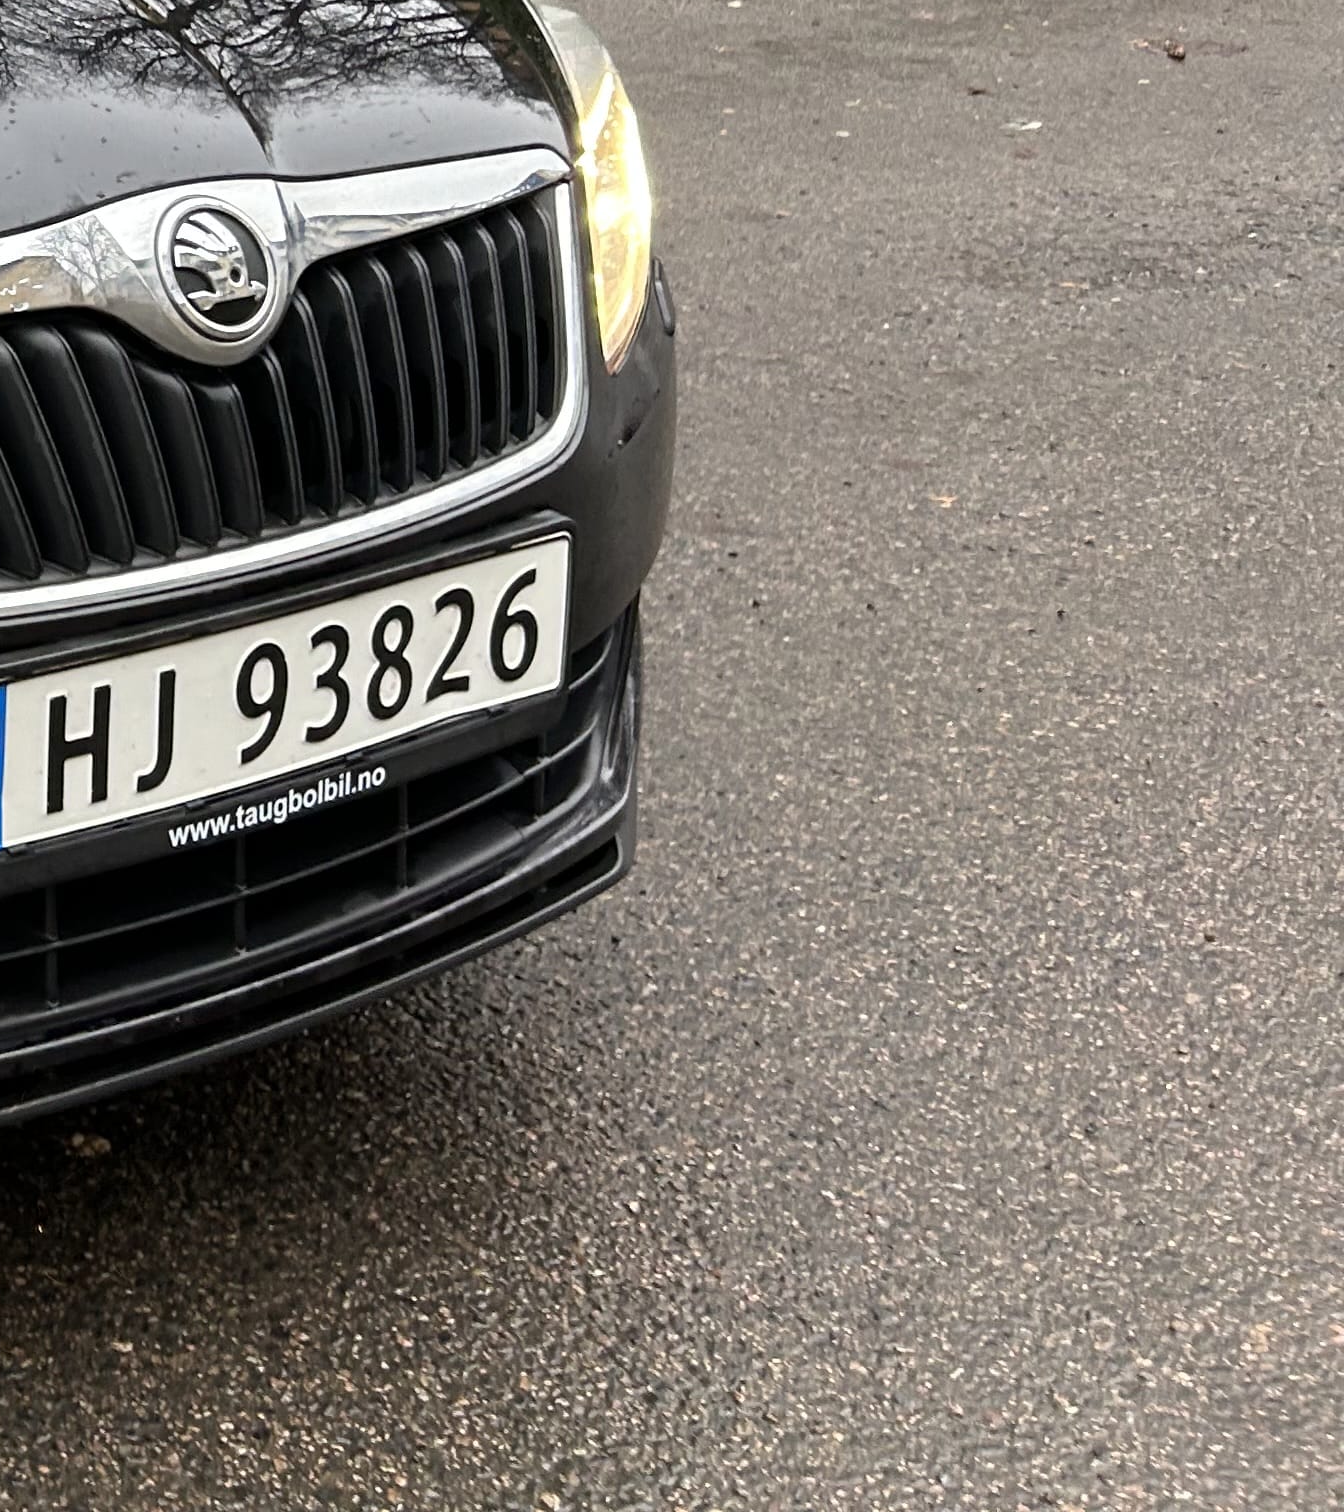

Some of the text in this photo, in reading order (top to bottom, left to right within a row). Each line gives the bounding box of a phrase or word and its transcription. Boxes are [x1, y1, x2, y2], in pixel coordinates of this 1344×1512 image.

[46, 567, 540, 815] HJ 93826
[168, 763, 387, 849] www.taugbolbil.no
